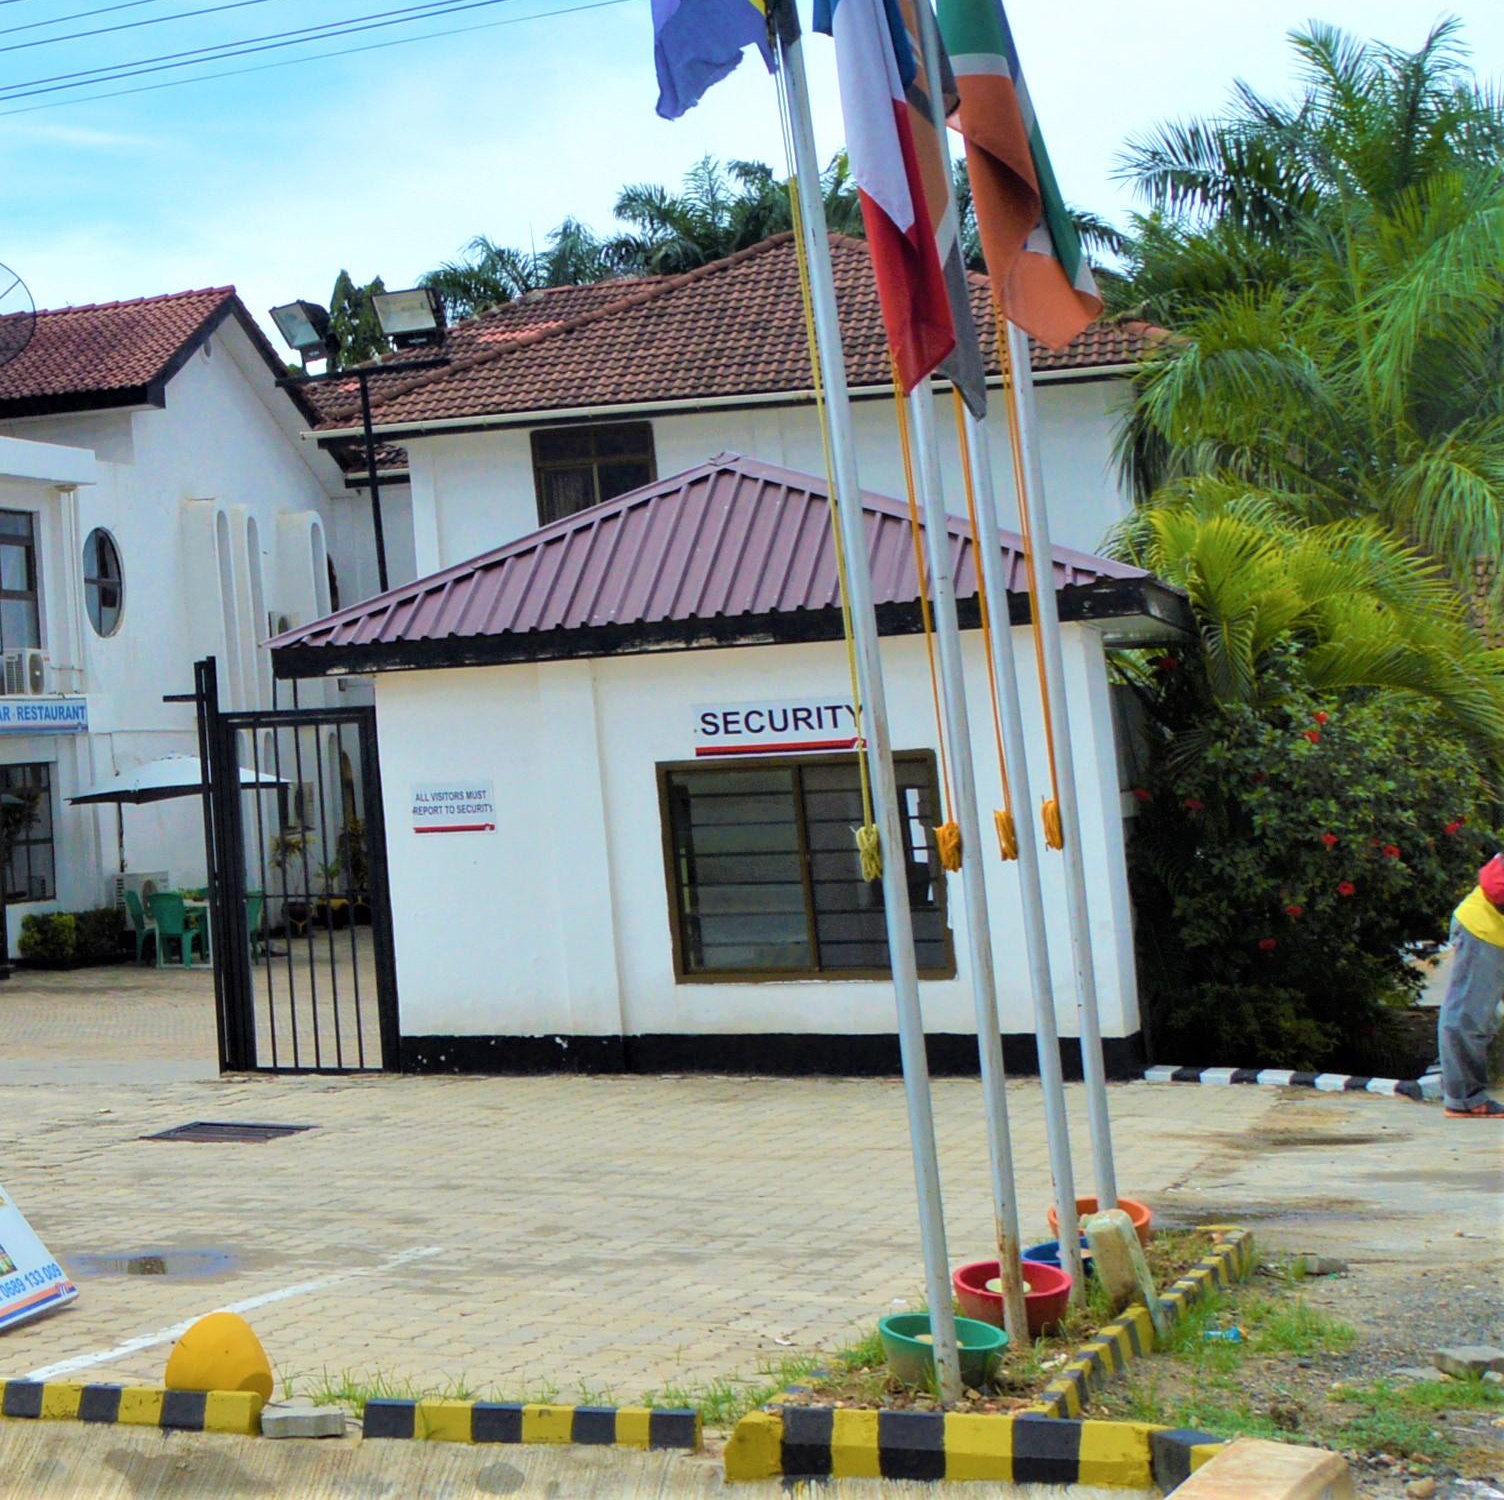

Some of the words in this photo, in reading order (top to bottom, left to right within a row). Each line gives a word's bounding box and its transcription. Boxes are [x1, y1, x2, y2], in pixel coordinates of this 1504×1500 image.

[16, 706, 86, 720] RESTAURANT
[700, 704, 863, 736] SECURITY
[416, 793, 429, 802] ALL
[431, 791, 464, 801] VISITORS
[465, 790, 486, 800] MUST
[413, 806, 443, 815] REPORT
[445, 805, 455, 814] TO
[457, 804, 492, 814] SECURITY
[0, 1278, 26, 1298] 0689
[25, 1271, 45, 1288] 133
[43, 1263, 62, 1280] 009
